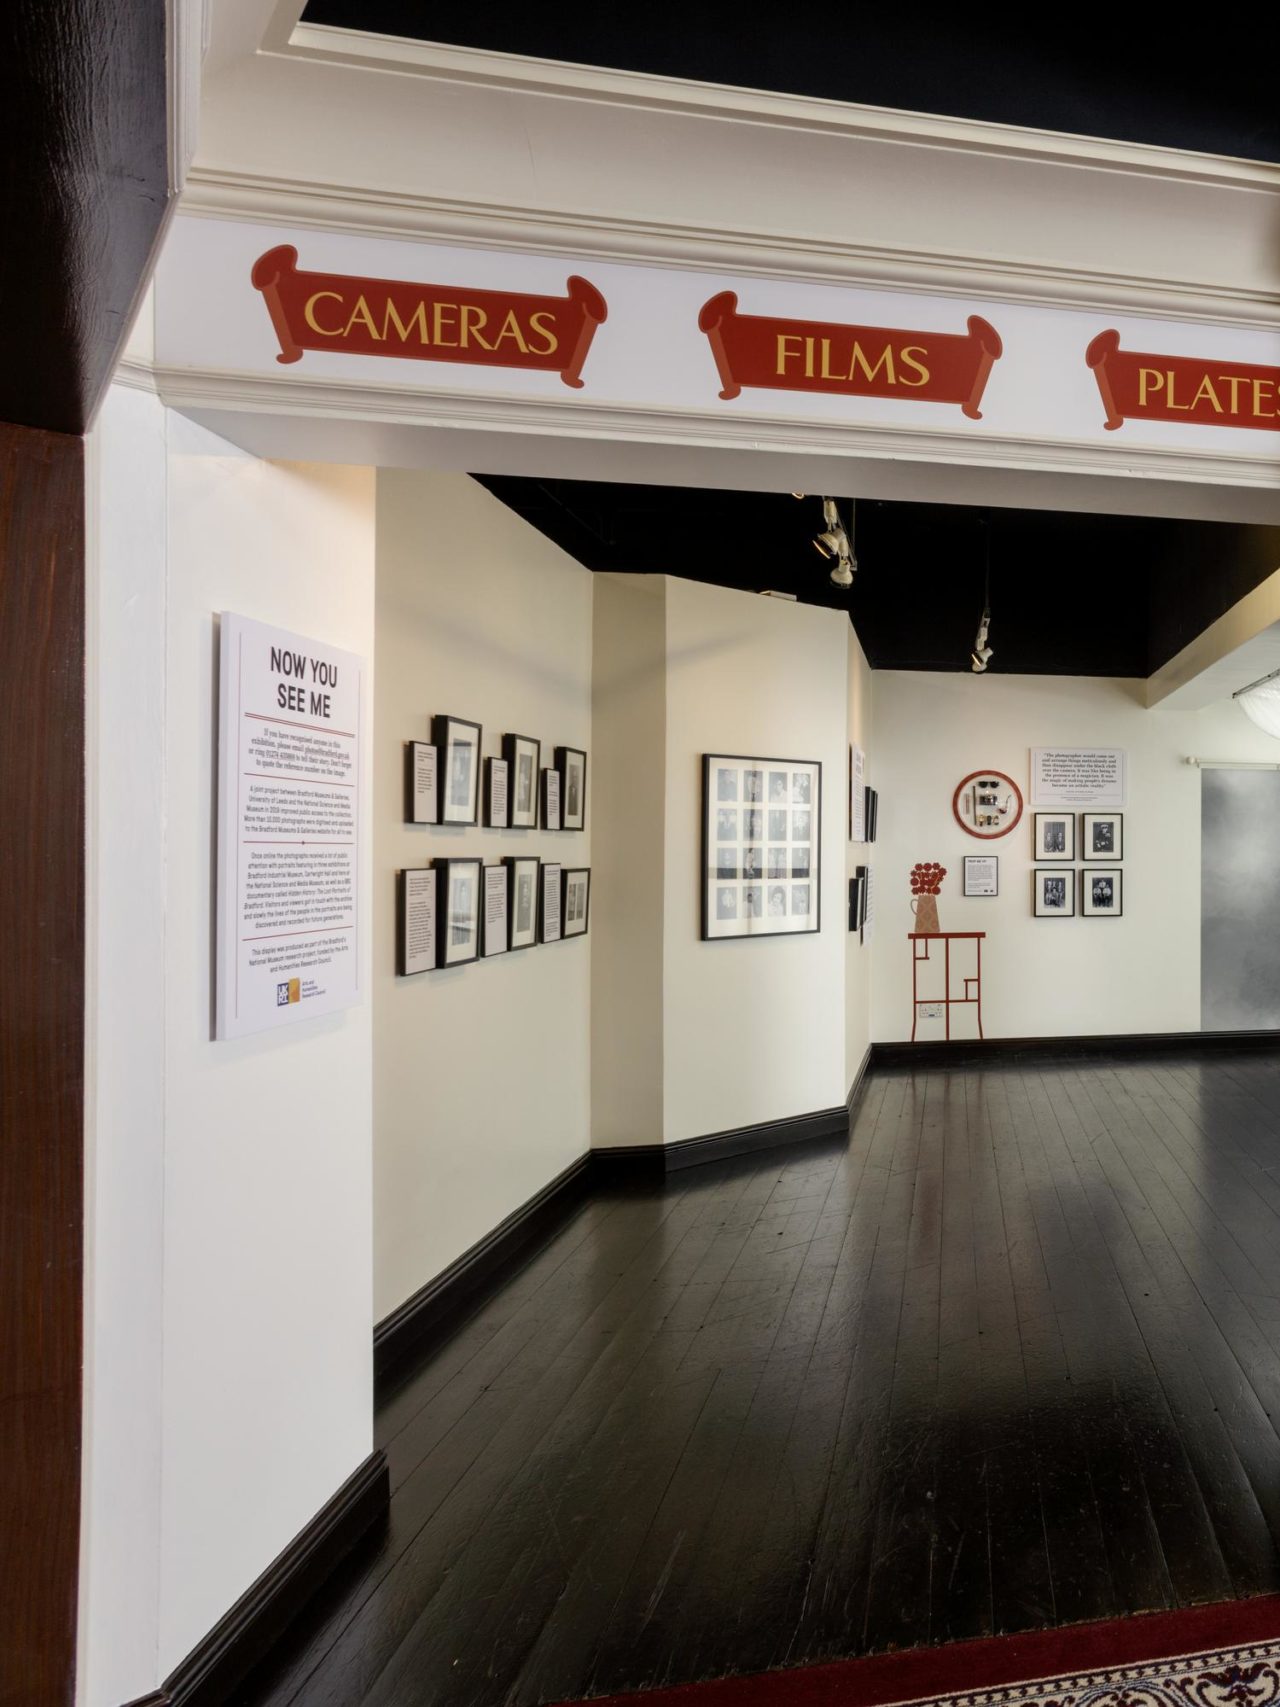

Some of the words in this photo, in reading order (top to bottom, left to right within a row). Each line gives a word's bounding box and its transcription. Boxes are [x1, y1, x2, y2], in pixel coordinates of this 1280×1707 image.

[304, 292, 558, 355] CAMERAS
[776, 335, 930, 386] FILMS
[271, 646, 306, 679] NOW
[310, 659, 337, 688] YOU
[278, 683, 305, 712] SEE
[311, 691, 330, 718] ME
